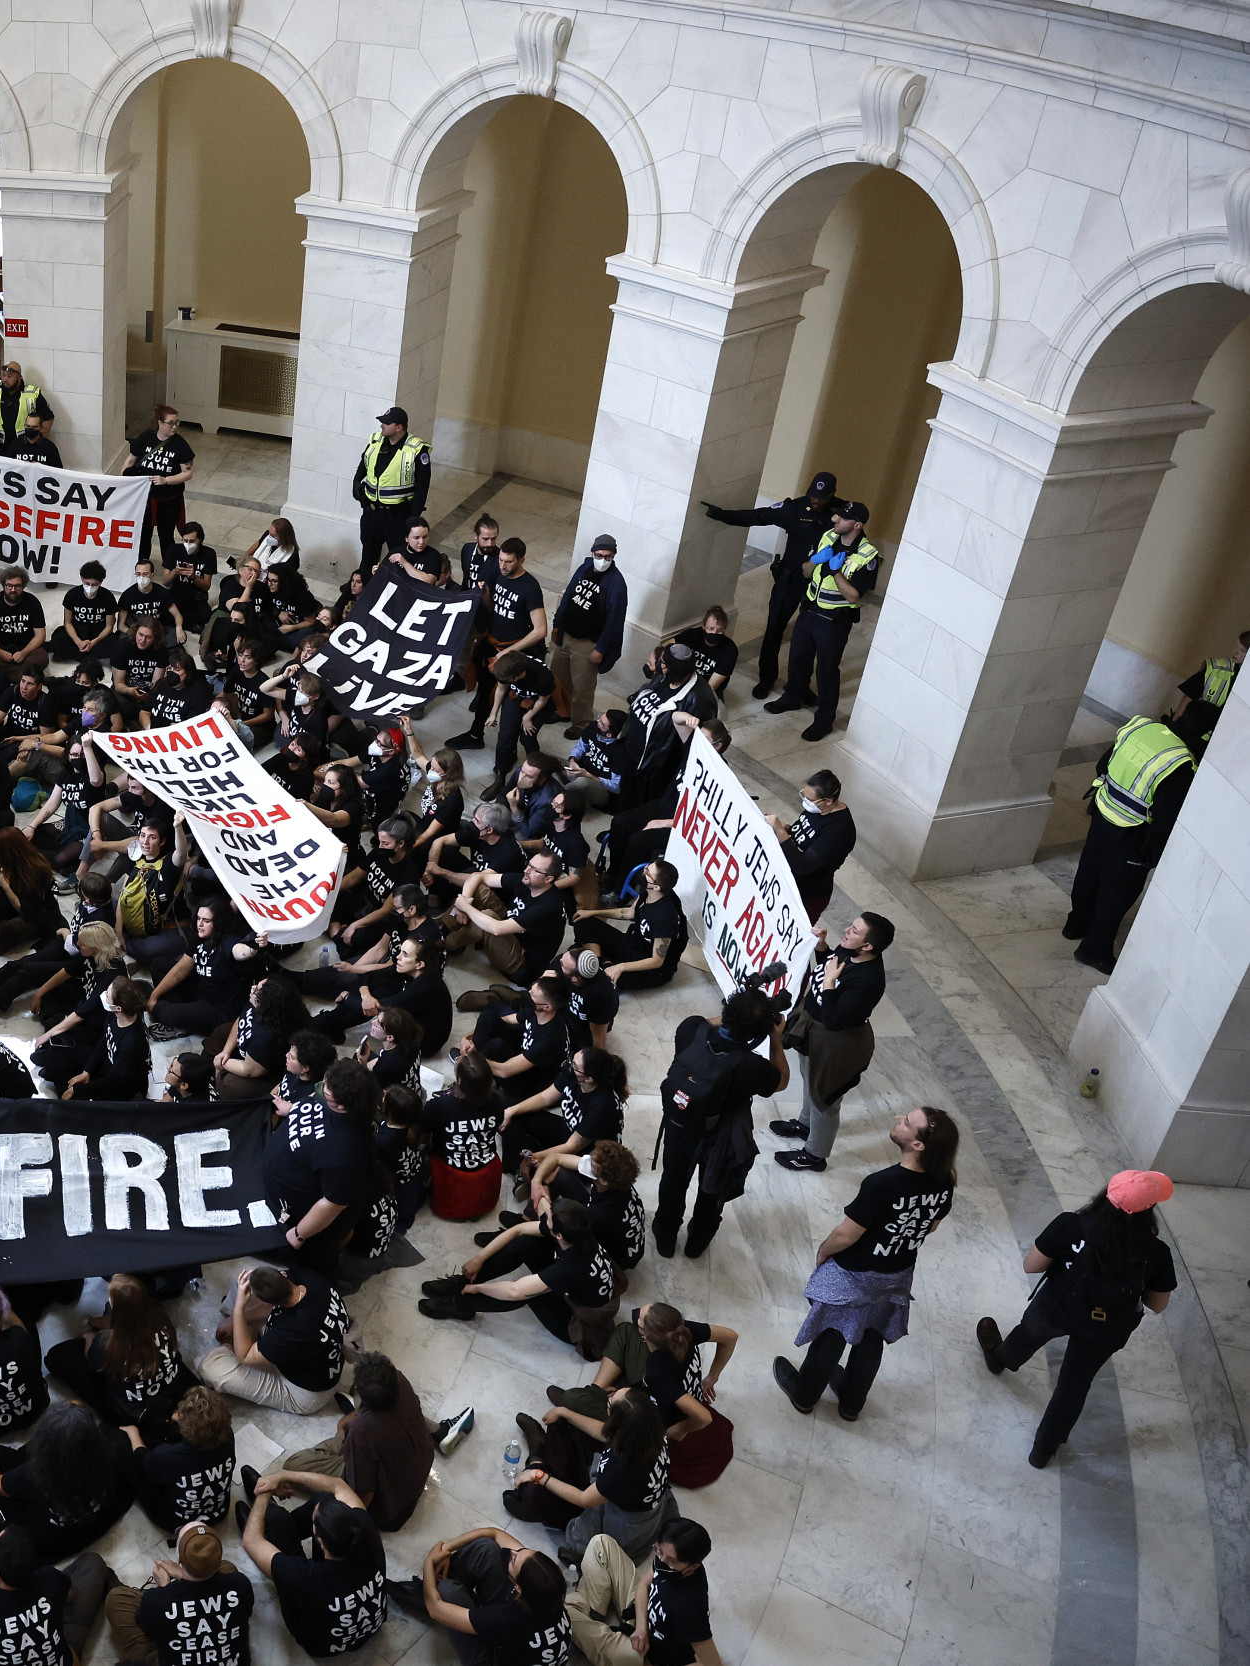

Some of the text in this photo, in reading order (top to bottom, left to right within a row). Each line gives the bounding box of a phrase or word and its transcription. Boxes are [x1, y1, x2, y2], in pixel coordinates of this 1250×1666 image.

[7, 324, 27, 333] EXIT
[35, 477, 117, 511] SAY
[131, 602, 149, 611] NOT
[493, 594, 511, 609] OUR
[509, 591, 519, 602] IN
[368, 581, 472, 646] LET
[494, 605, 516, 620] AME
[329, 621, 452, 690] GAZA
[249, 690, 258, 700] IN
[12, 713, 34, 726] OUR
[29, 711, 39, 719] IN
[632, 703, 649, 725] NAM
[108, 717, 223, 754] LIVING
[178, 742, 240, 773] FOR
[145, 771, 244, 797] HELL
[221, 829, 277, 851] AND
[672, 787, 740, 910] NEVER
[693, 758, 803, 961] PHILLY JEWS SAY
[250, 872, 317, 899] THE
[367, 873, 384, 894] OUR
[370, 861, 395, 890] NOT IN
[702, 891, 716, 930] IS
[288, 1101, 300, 1152] NAME
[299, 1103, 313, 1139] OUR
[314, 1121, 326, 1140] IN
[445, 1115, 496, 1133] JEWS
[452, 1130, 489, 1145] SAY
[892, 1190, 949, 1210] JEWS
[897, 1207, 940, 1224] SAY
[319, 1287, 340, 1343] JEWS
[176, 1457, 232, 1488] JEWS
[185, 1476, 229, 1501] SAY
[328, 1570, 384, 1612] JEWS
[164, 1589, 240, 1620] JEWS
[339, 1591, 382, 1627] SAY
[1, 1619, 49, 1654] SAY
[168, 1625, 241, 1651] CEASE
[177, 1612, 231, 1639] SAY
